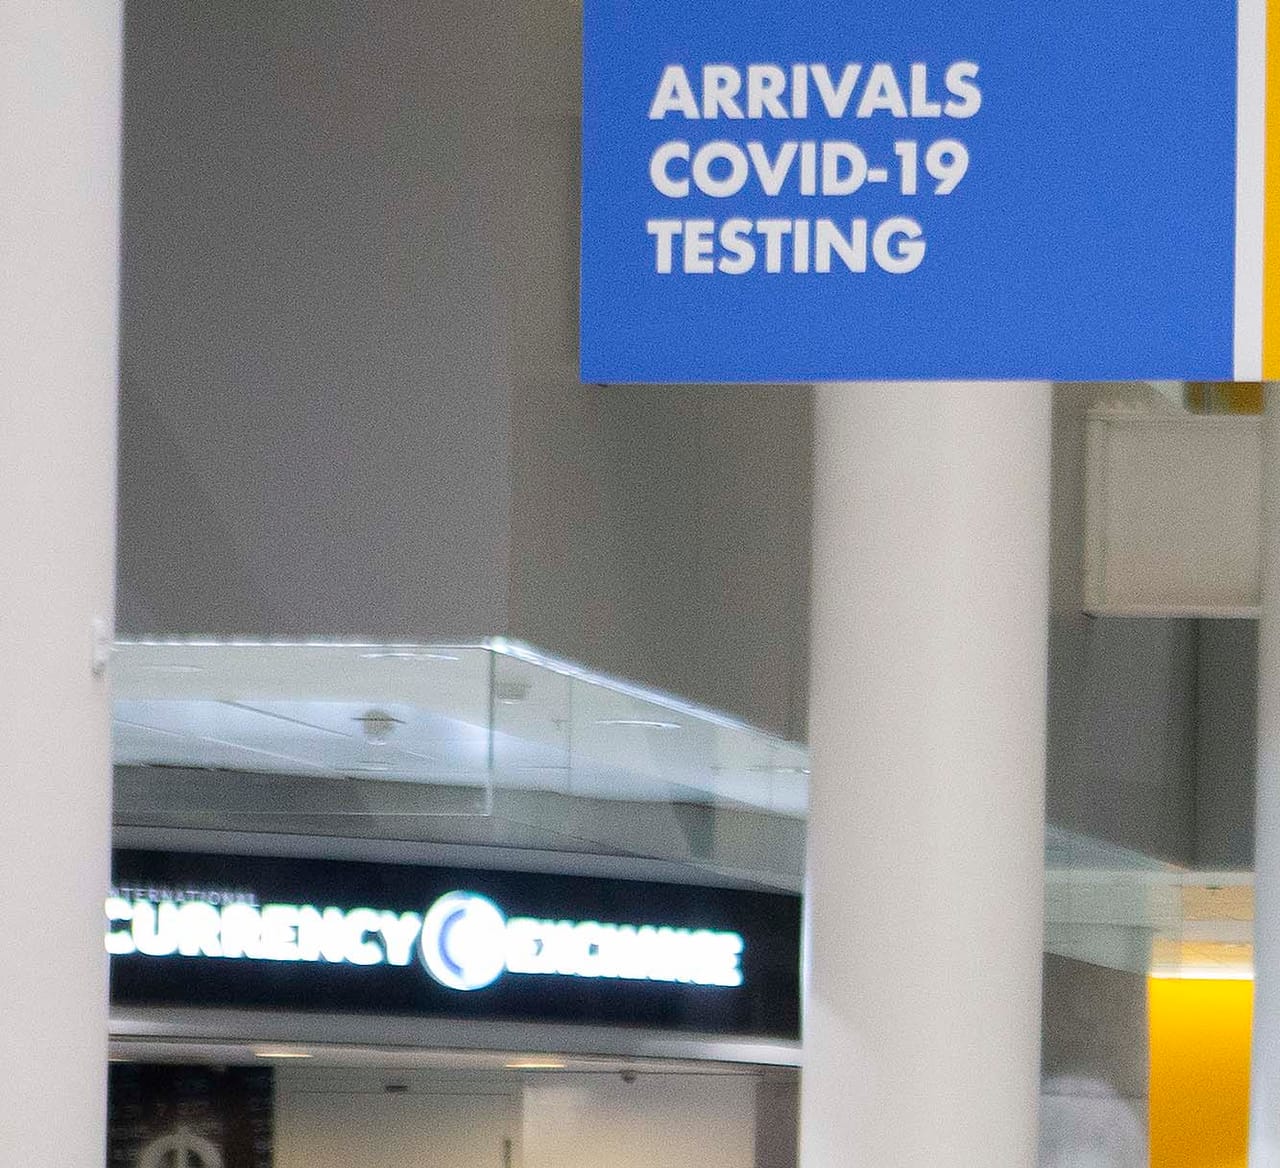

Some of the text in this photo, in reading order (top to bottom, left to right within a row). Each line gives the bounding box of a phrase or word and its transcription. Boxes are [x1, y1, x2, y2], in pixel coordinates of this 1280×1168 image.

[648, 62, 983, 120] ARRIVALS
[649, 140, 970, 198] COVID-19
[647, 217, 926, 275] TESTING
